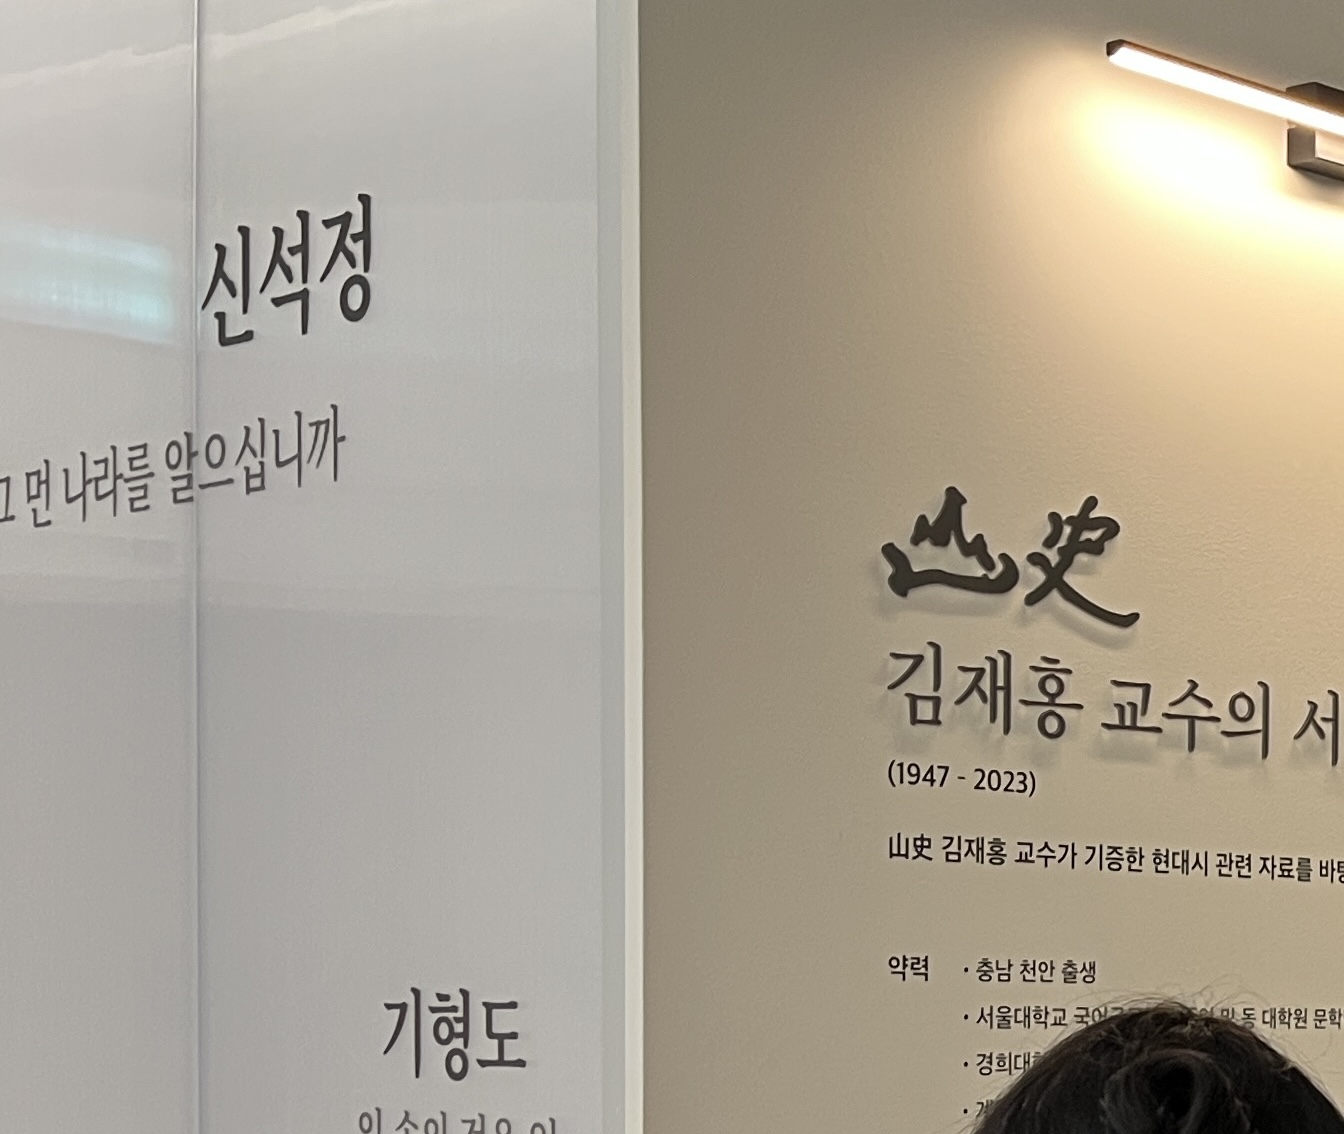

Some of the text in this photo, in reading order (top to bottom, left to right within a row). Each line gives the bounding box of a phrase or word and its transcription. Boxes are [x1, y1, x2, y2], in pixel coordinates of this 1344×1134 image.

[201, 192, 372, 348] 신석정
[25, 459, 52, 528] 먼
[62, 443, 155, 522] 나라를
[164, 403, 347, 504] 알으십니까
[881, 486, 1140, 628] 山史
[887, 641, 1084, 739] 김재홍
[1100, 679, 1270, 761] 교수의
[887, 759, 950, 788] (1947
[973, 769, 1037, 798] 2023)
[888, 832, 934, 861] 山史
[941, 835, 1008, 866] 김재홍
[1013, 841, 1078, 870] 교수가
[1084, 843, 1145, 874] 기증한
[1151, 847, 1209, 878] 현대시
[1215, 852, 1252, 880] 관련
[1258, 854, 1314, 883] 자료를
[888, 954, 931, 983] 약력
[975, 957, 1097, 985] 충남 천안 출생
[383, 986, 528, 1083] 기형도
[975, 1004, 1069, 1031] 서울대학교
[1261, 1007, 1309, 1030] 대학원
